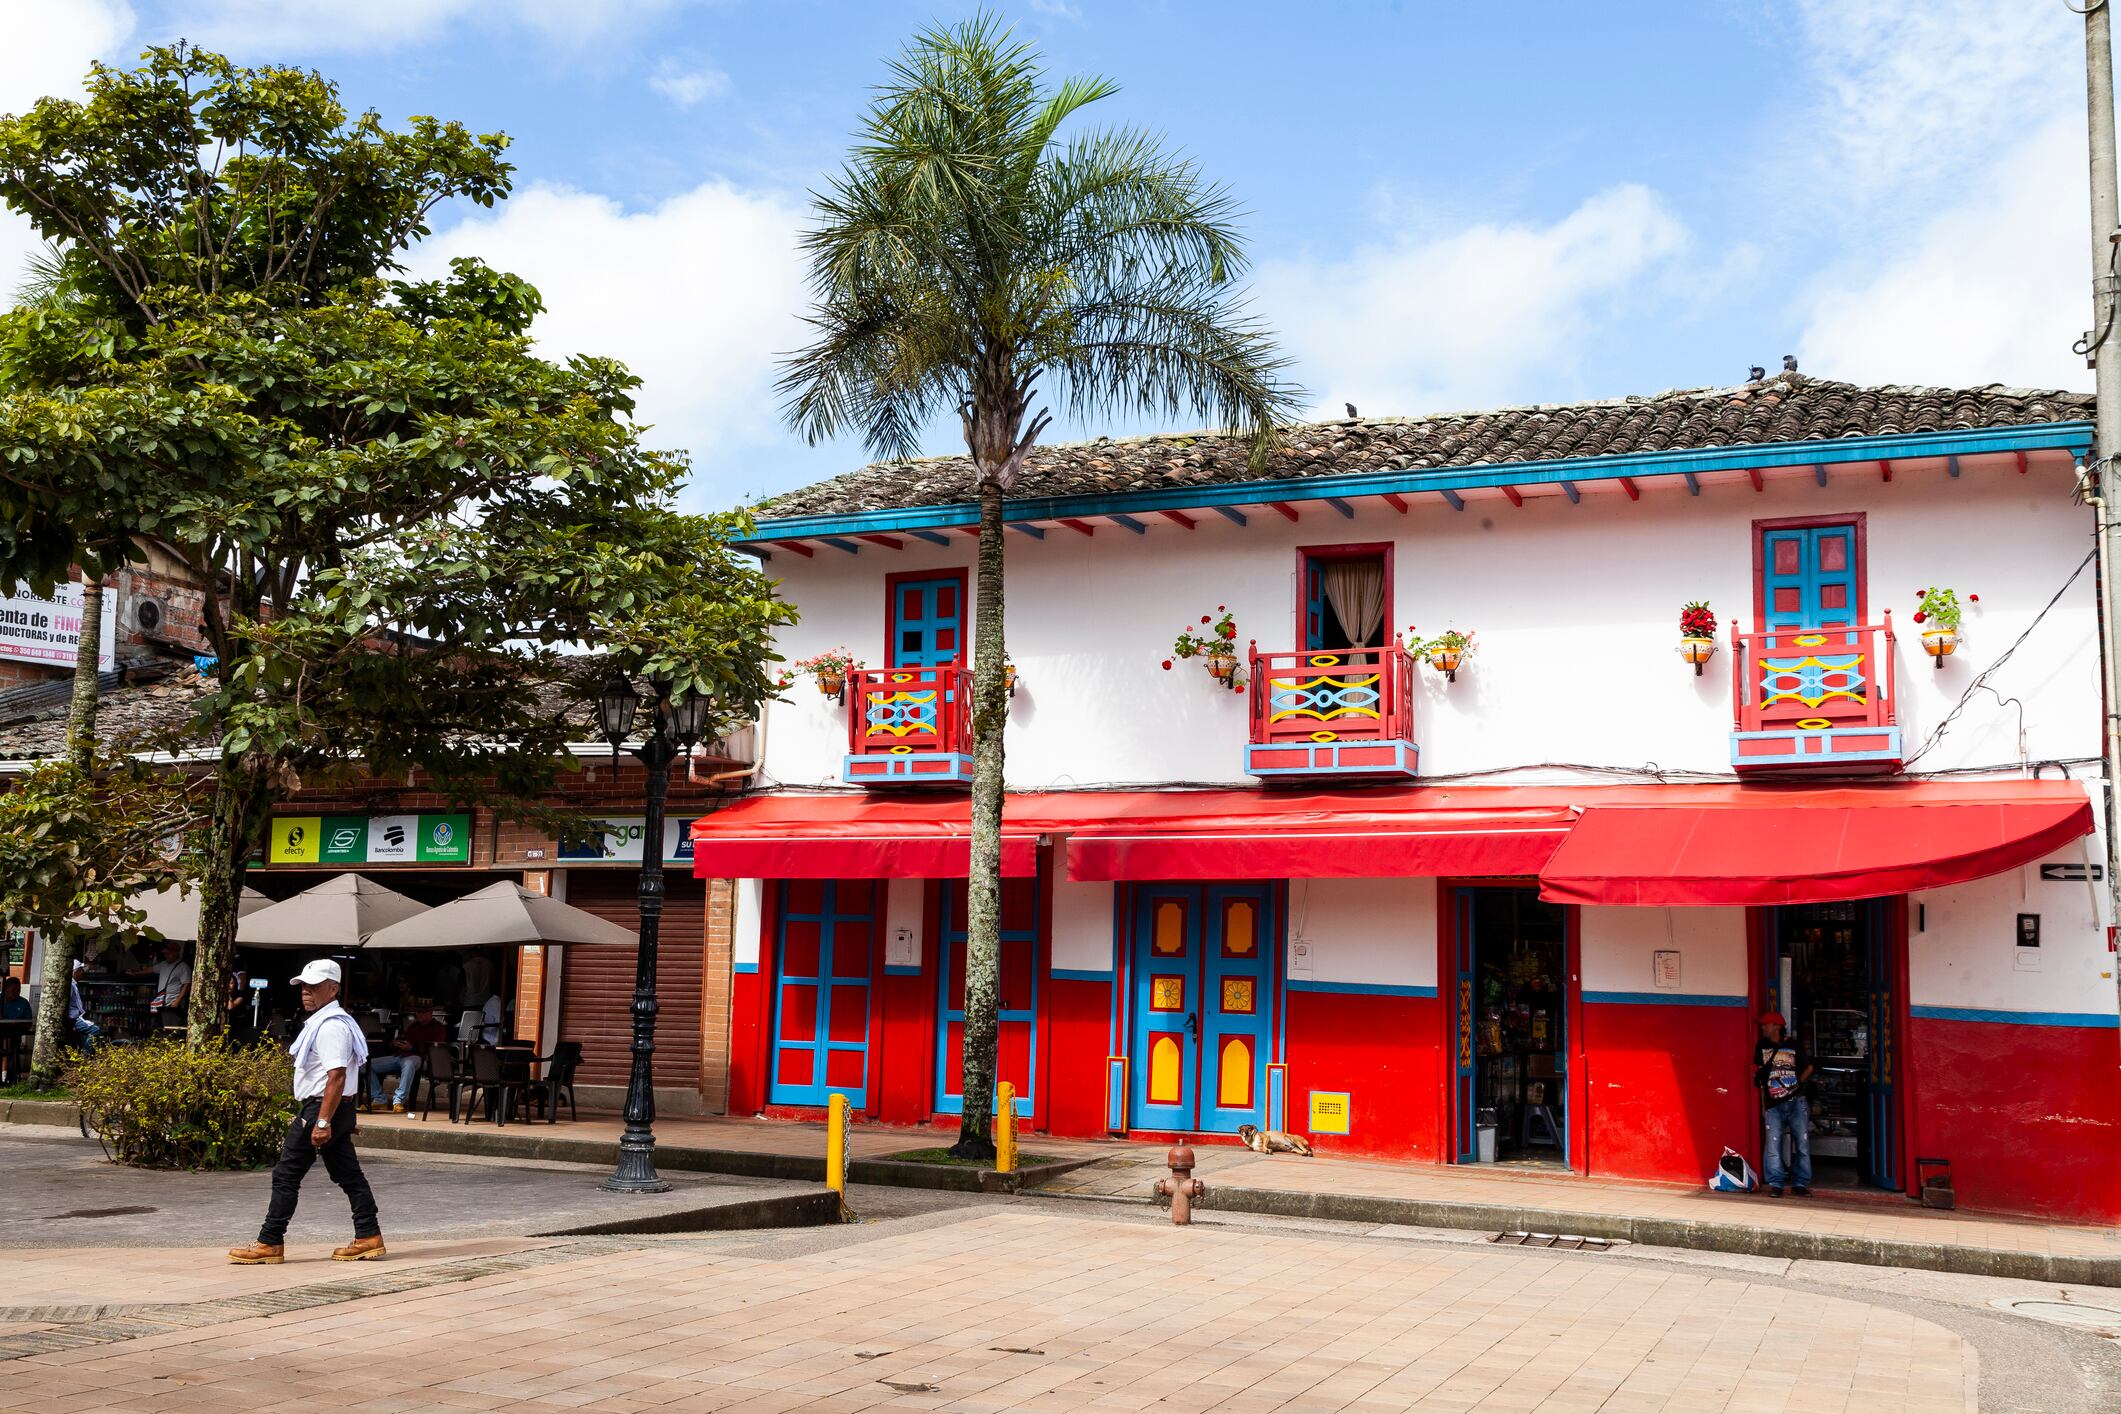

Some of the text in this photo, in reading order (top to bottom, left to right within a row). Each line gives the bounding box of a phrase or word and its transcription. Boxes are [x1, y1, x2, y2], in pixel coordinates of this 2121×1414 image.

[30, 611, 49, 628] de
[49, 633, 55, 642] y
[55, 633, 67, 644] de
[681, 841, 692, 849] SU
[284, 847, 305, 856] efecty
